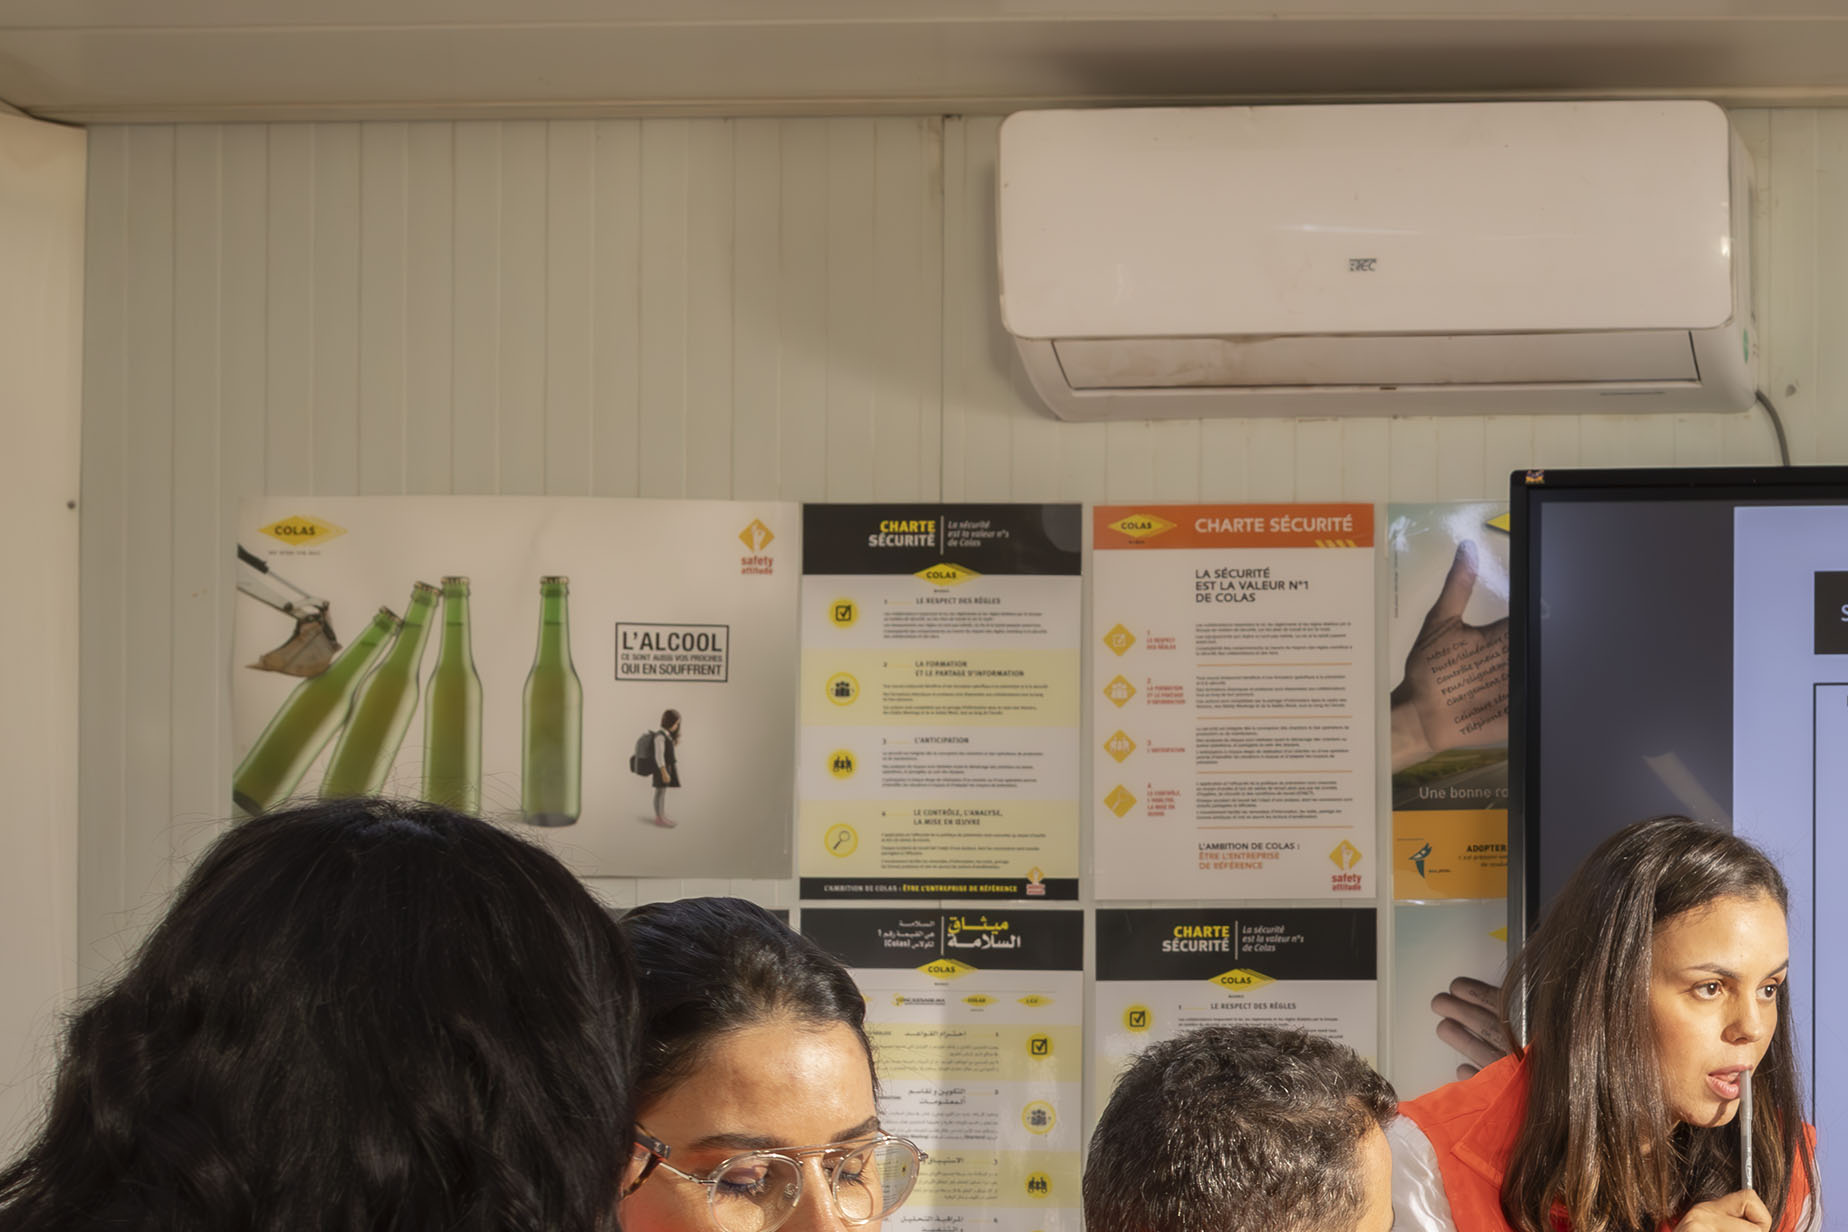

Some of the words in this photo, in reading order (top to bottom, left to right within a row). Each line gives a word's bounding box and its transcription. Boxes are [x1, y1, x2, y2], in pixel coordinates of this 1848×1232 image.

[880, 520, 936, 533] CHARTE
[1121, 522, 1152, 530] COLAS
[1195, 517, 1264, 533] CHARTE
[1270, 514, 1353, 532] SÉCURITÉ
[275, 526, 316, 536] COLAS
[868, 532, 936, 547] SÉCURITÉ
[741, 555, 773, 568] safety
[1196, 570, 1210, 579] LA
[1215, 568, 1270, 579] SÉCURITÉ
[1196, 581, 1216, 591] EST
[1220, 581, 1235, 591] LA
[1240, 581, 1285, 591] VALEUR
[1289, 580, 1309, 590] N°1
[1196, 593, 1211, 603] DE
[1216, 593, 1256, 603] COLAS
[623, 631, 722, 652] L’ALCOOL
[622, 663, 639, 674] QUI
[642, 663, 656, 674] EN
[659, 663, 722, 675] SOUFFRENT
[1419, 787, 1446, 799] Une
[1450, 786, 1491, 798] bonne
[1332, 873, 1362, 884] safety
[1332, 883, 1362, 891] attitude
[1174, 925, 1230, 938] CHARTE
[1242, 925, 1252, 934] La
[1254, 925, 1285, 934] sécurité
[1162, 938, 1230, 952] SÉCURITÉ
[1242, 944, 1252, 952] de
[1254, 944, 1276, 952] Colas
[1211, 1002, 1219, 1010] LE
[1221, 1002, 1251, 1010] RESPECT
[1254, 1002, 1268, 1010] DES
[1270, 1002, 1296, 1010] RÈGLES
